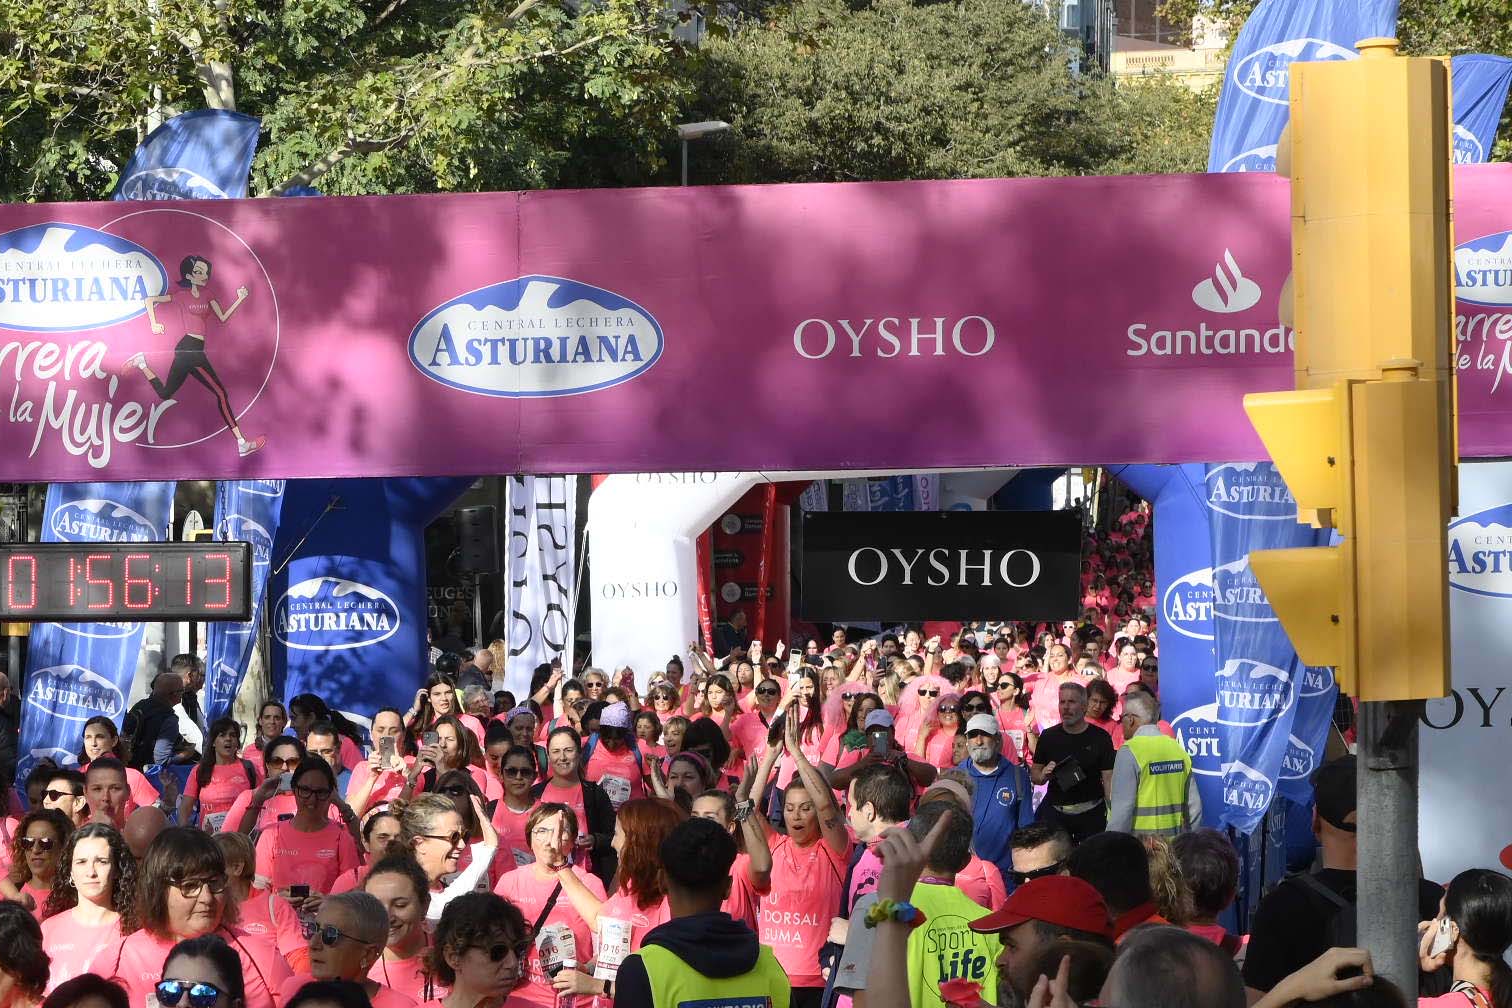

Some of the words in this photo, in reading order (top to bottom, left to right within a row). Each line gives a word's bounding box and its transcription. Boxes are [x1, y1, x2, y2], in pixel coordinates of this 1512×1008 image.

[467, 317, 548, 331] CENTRAL
[554, 316, 636, 330] LECHERA
[792, 314, 996, 360] OYSHO
[428, 322, 645, 368] ASTURIANA
[10, 383, 34, 424] la
[29, 381, 178, 469] Mujer
[847, 547, 1041, 587] OYSHO
[602, 580, 678, 599] OYSHO
[278, 606, 391, 634] ASTURIANA
[290, 602, 332, 611] CENTRAL
[338, 601, 387, 610] LECHERA
[28, 678, 117, 715] ASTURIANA
[764, 911, 819, 926] DORSAL
[764, 927, 803, 944] SUMA
[928, 929, 977, 955] Sport
[938, 949, 987, 983] Life
